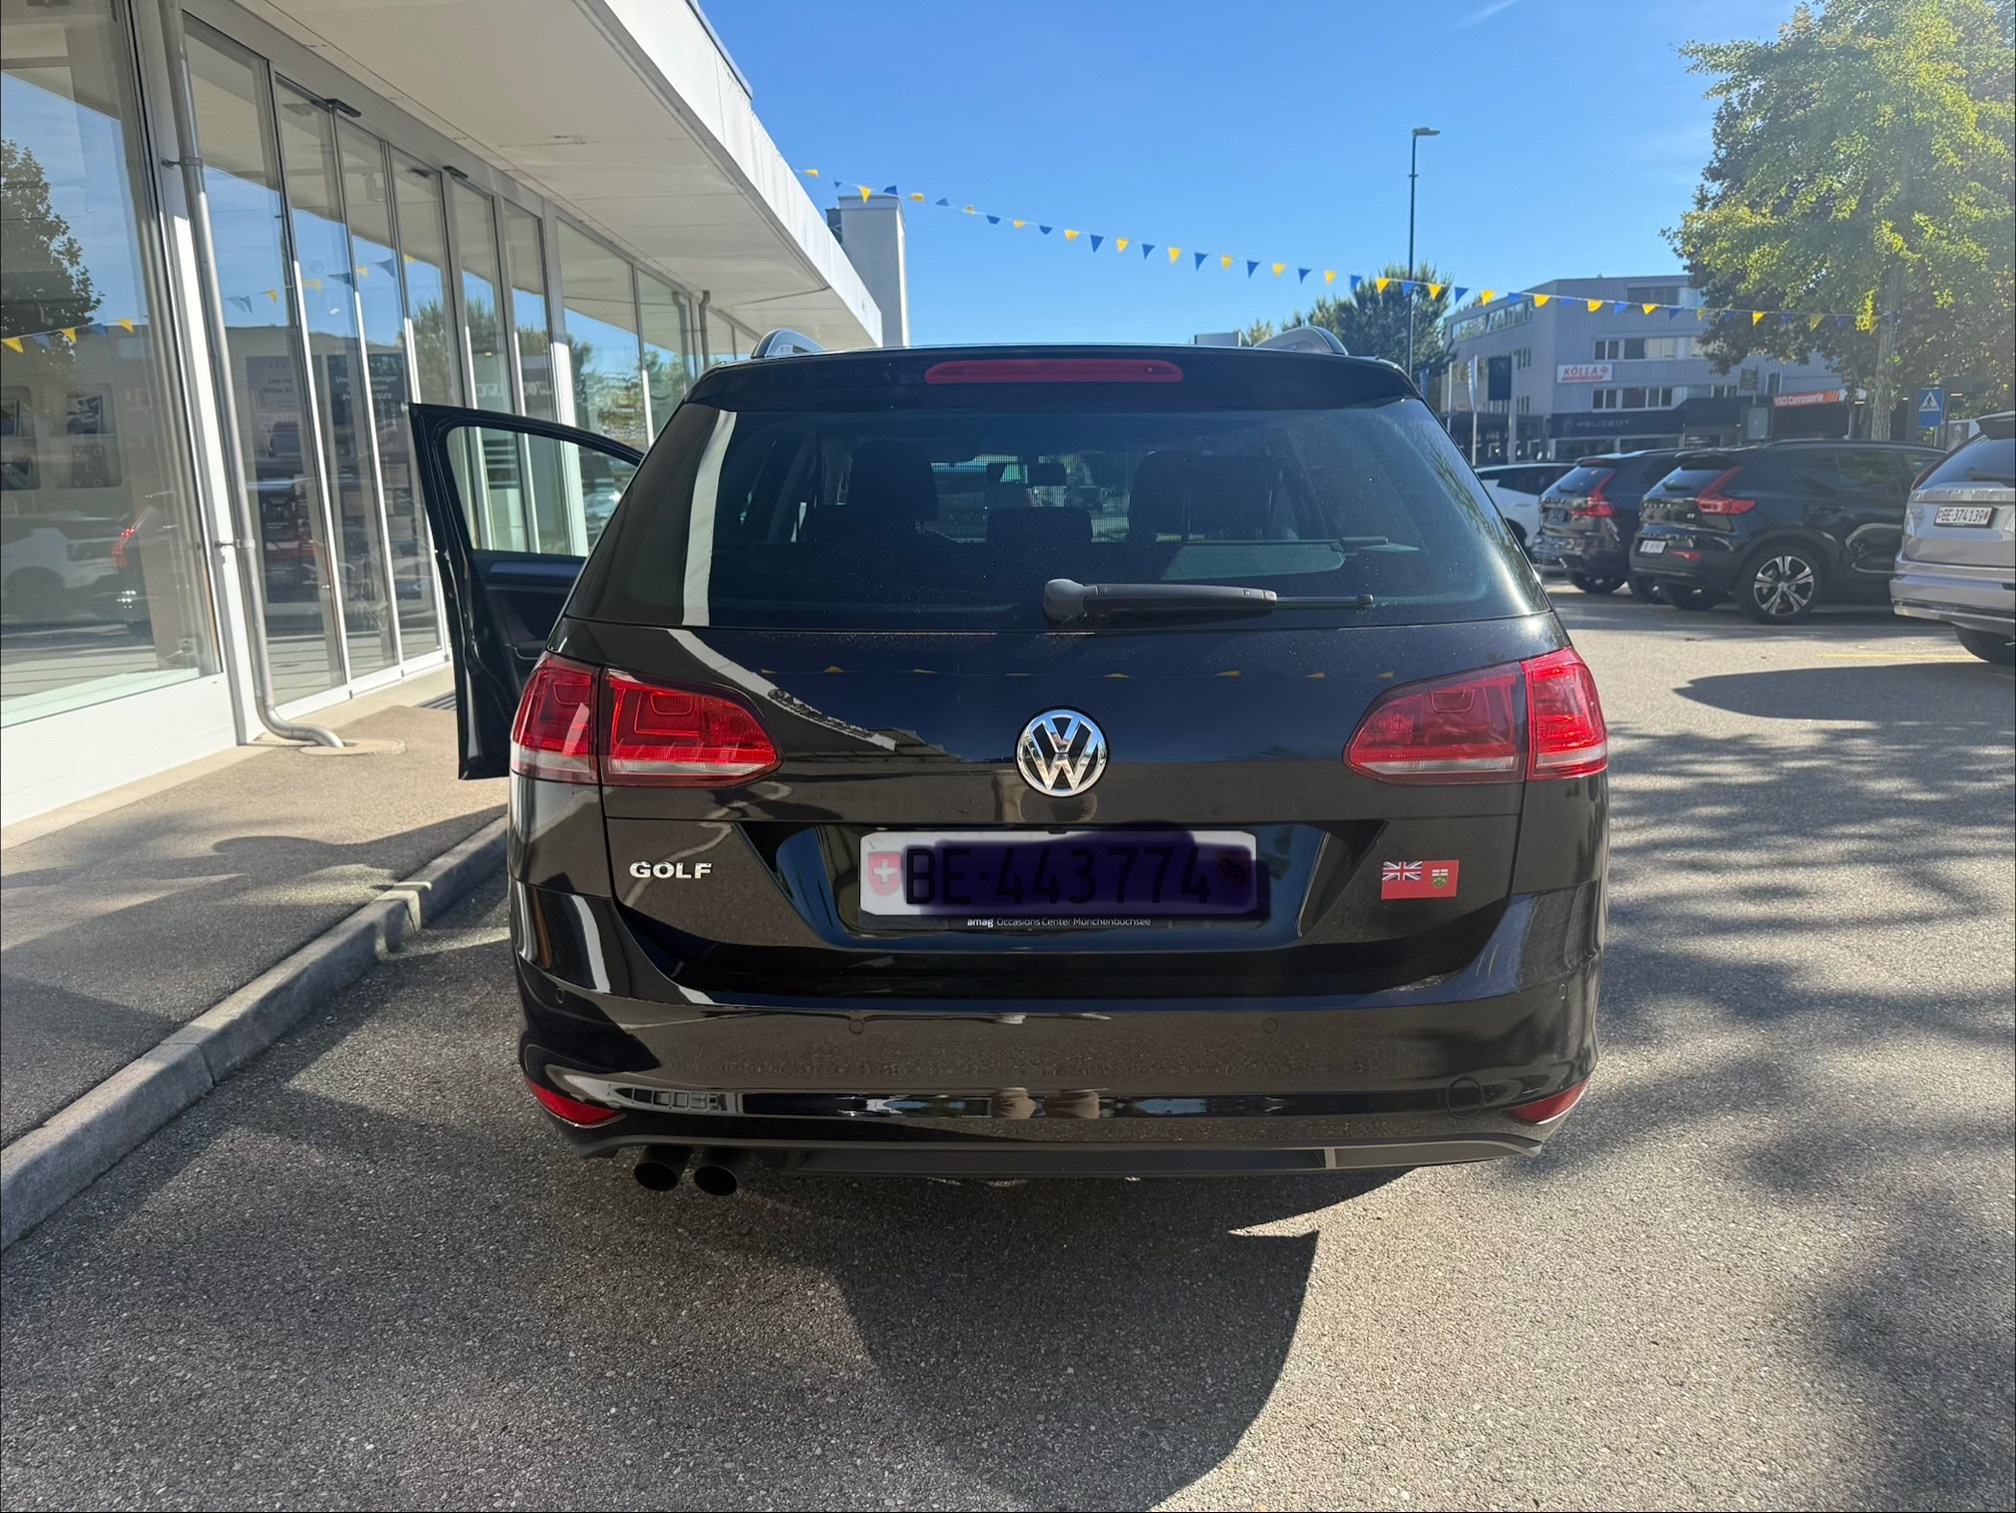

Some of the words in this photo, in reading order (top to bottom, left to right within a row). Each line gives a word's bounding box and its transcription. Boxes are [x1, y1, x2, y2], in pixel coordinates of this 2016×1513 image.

[1577, 420, 1631, 428] PEUGEOT
[629, 861, 712, 879] GOLF
[967, 918, 994, 928] amag
[996, 917, 1041, 926] Occasions
[1042, 917, 1072, 926] Center
[1073, 917, 1151, 926] Münchenbuchsee
